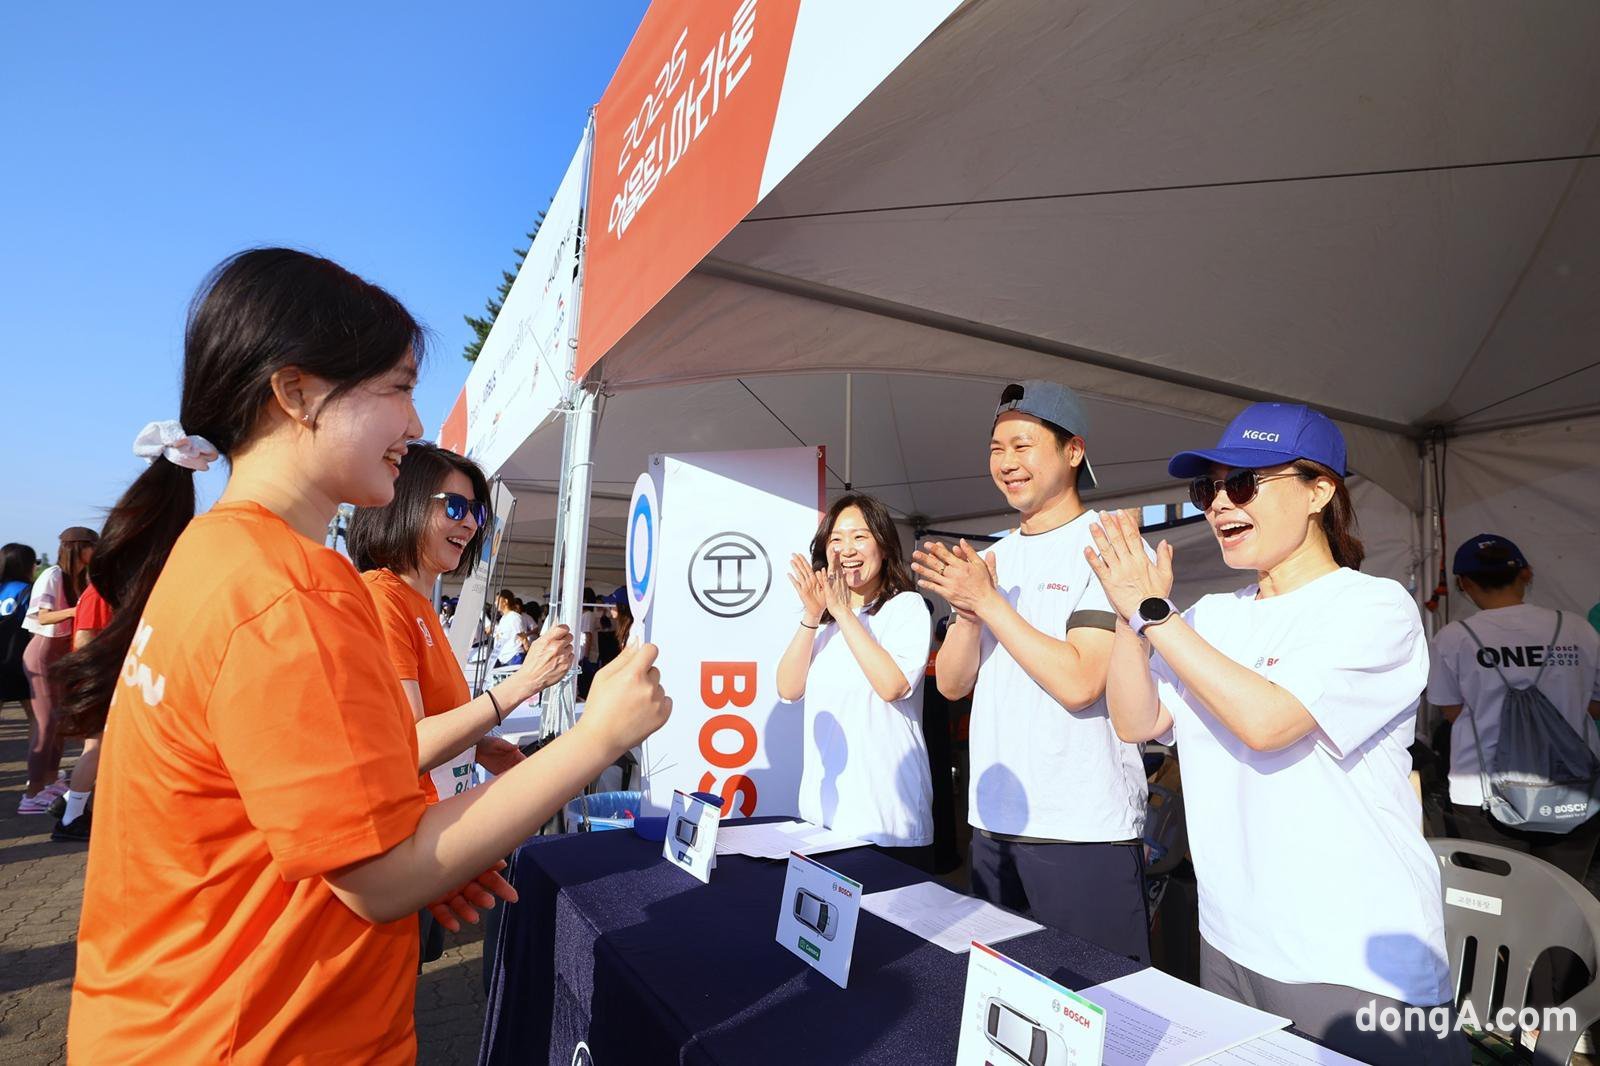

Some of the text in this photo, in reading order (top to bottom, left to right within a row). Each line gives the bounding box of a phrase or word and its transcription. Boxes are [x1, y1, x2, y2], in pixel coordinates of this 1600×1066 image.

[618, 26, 688, 176] 2026
[607, 0, 758, 240] 어울림 마라톤
[1242, 429, 1280, 443] KGCCI
[1554, 803, 1587, 814] BOSCH
[1063, 1006, 1091, 1029] BOSCH
